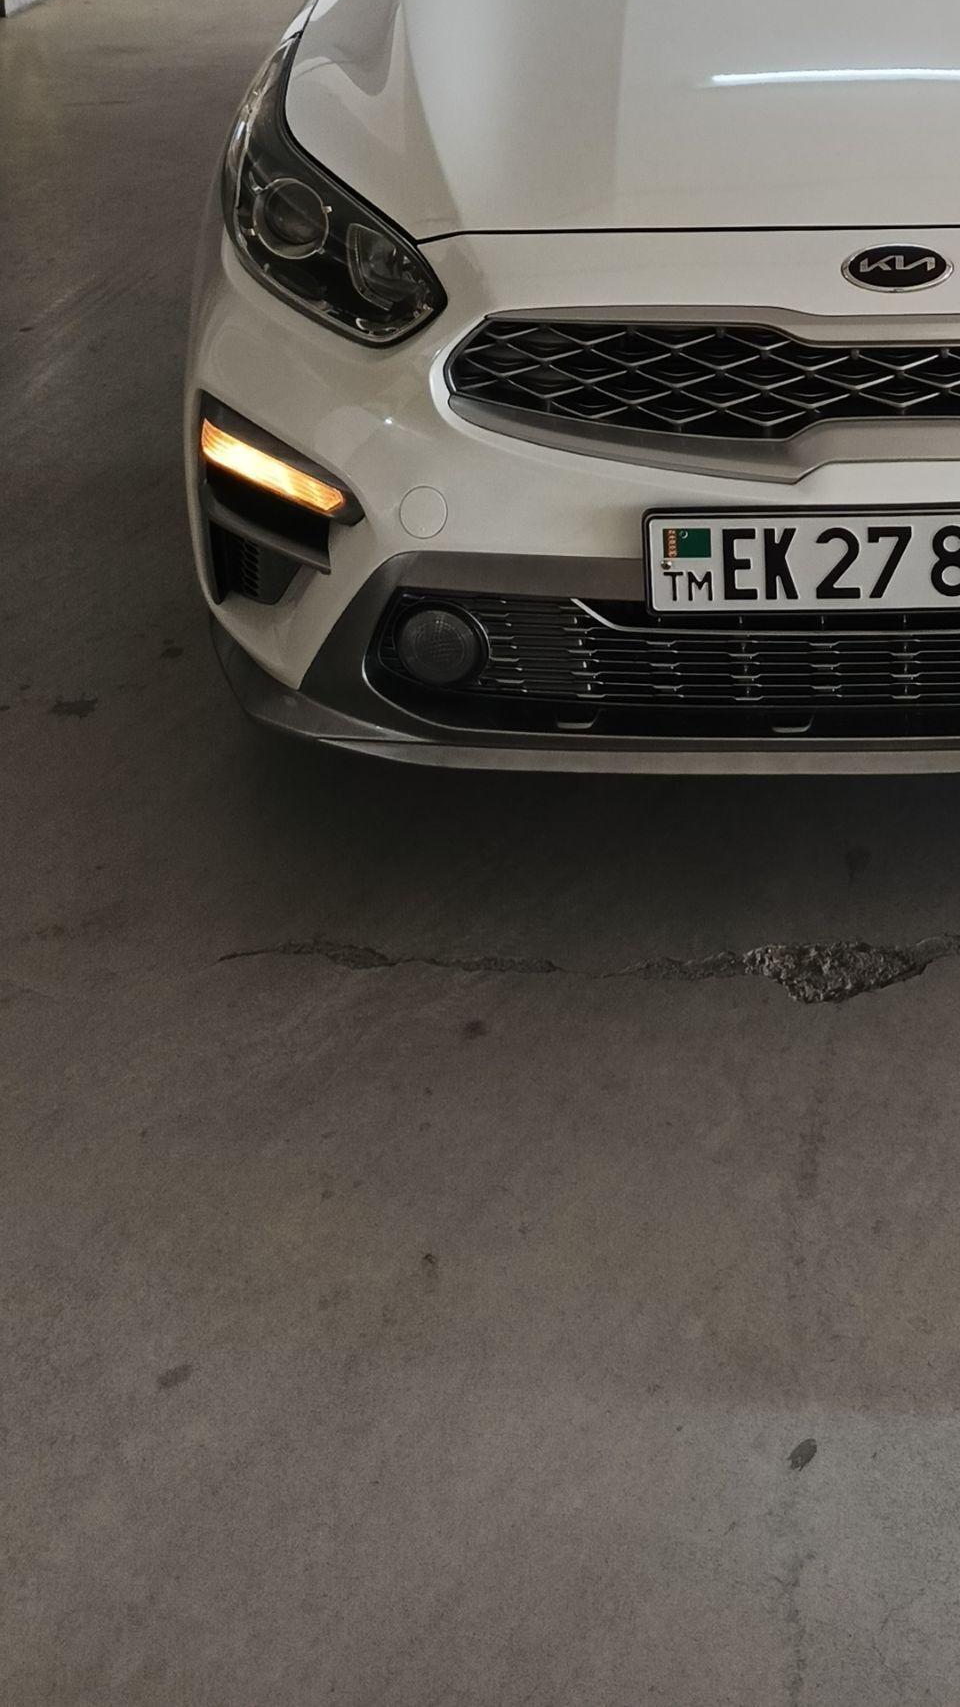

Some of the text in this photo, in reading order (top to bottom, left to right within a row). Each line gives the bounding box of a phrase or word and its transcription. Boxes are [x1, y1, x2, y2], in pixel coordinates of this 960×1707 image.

[858, 254, 936, 273] KIA
[721, 527, 799, 601] EK
[815, 526, 912, 600] 27
[662, 570, 714, 602] TM
